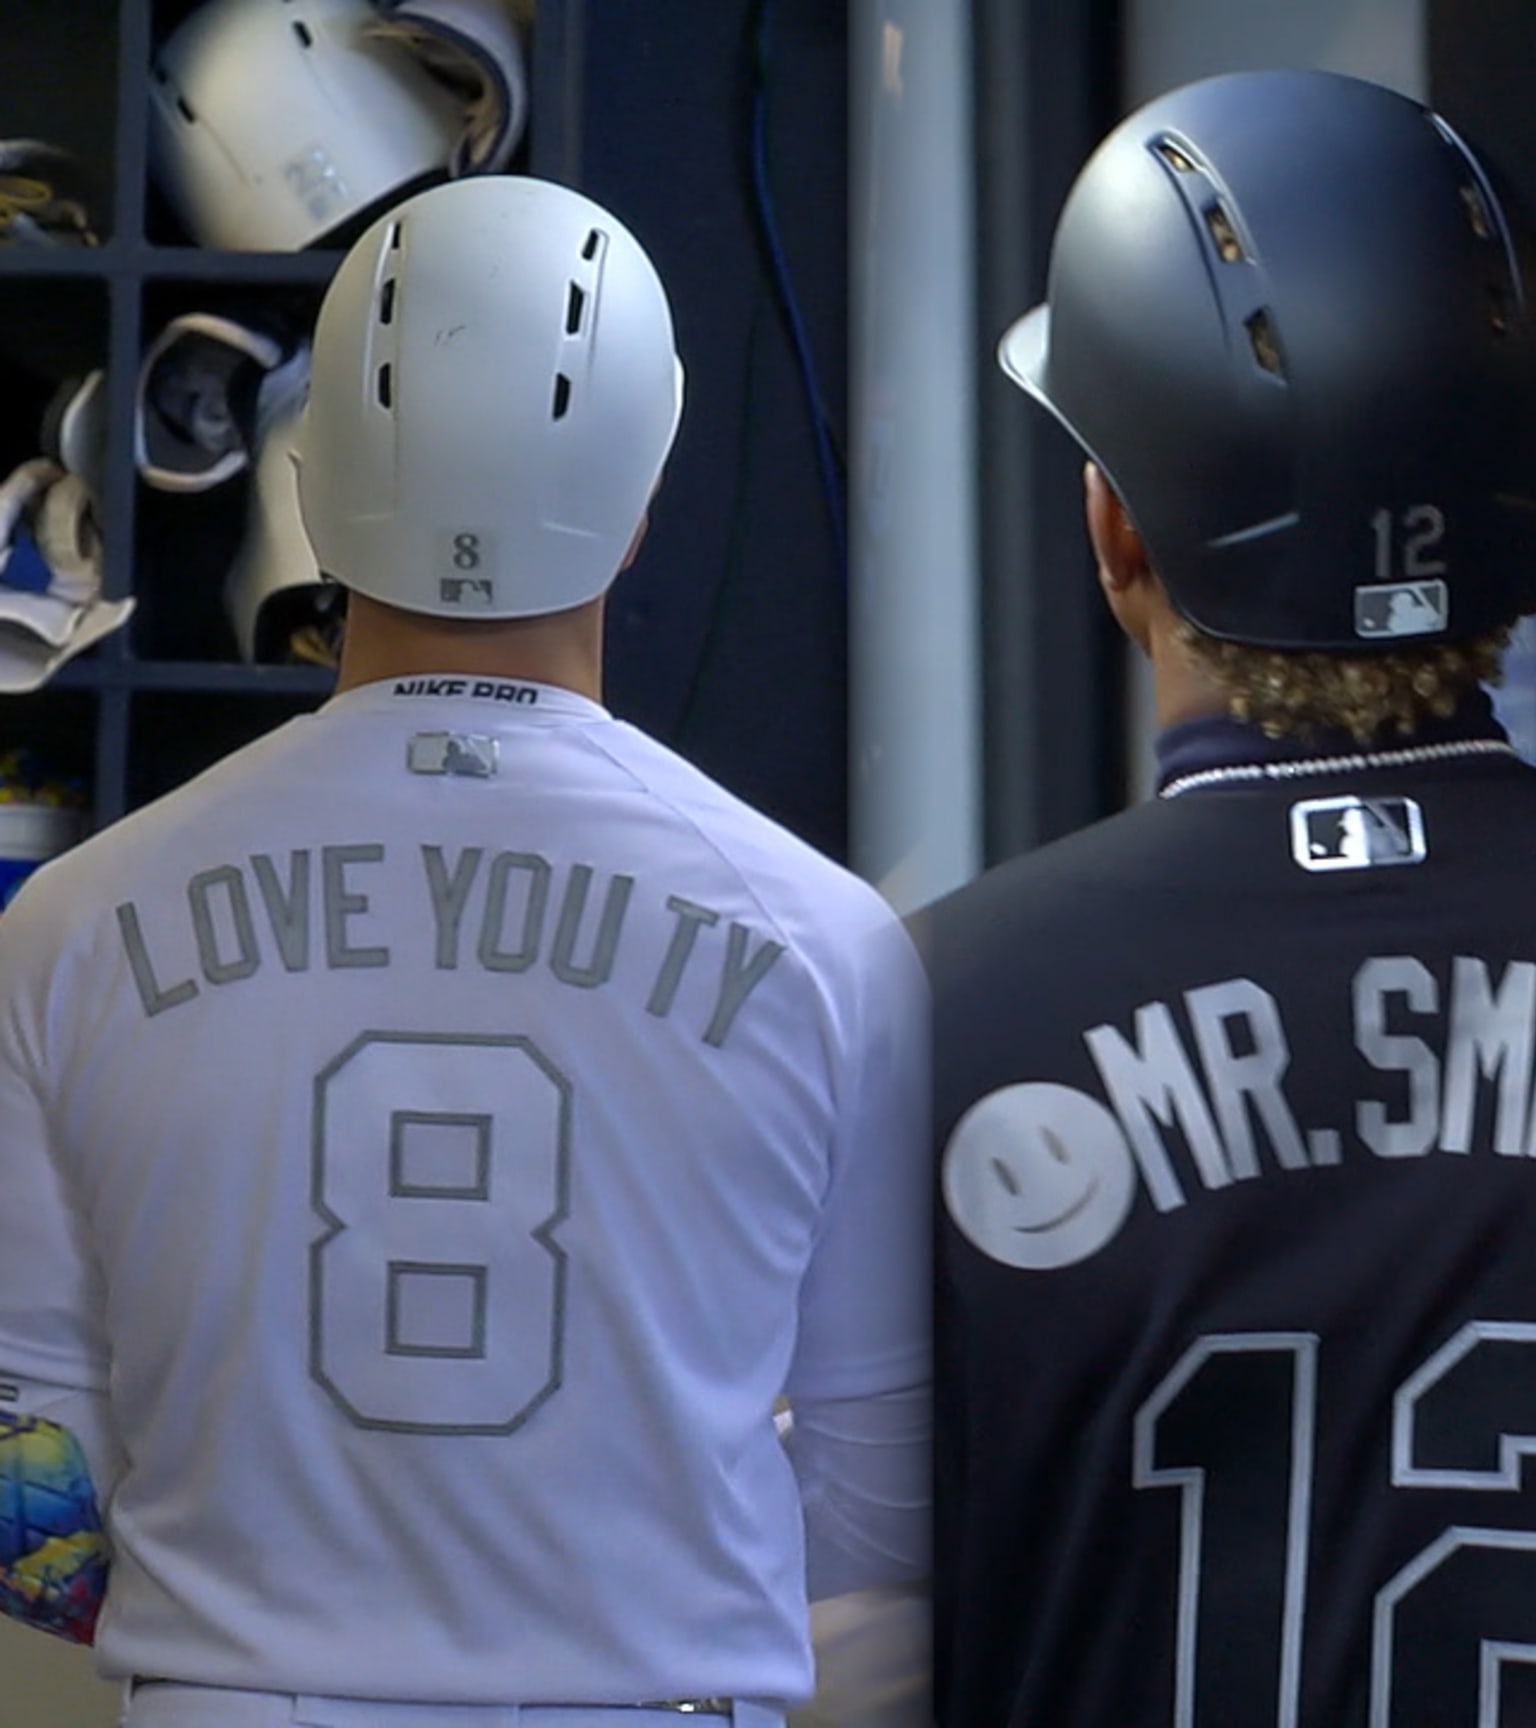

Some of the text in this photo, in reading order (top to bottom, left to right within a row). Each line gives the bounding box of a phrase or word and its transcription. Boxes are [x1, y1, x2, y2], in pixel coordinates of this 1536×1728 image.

[454, 533, 480, 570] 8
[1372, 505, 1447, 578] 12
[117, 845, 786, 1048] LOVE YOU TY
[1083, 978, 1342, 1212] MR.
[309, 1029, 573, 1436] 8
